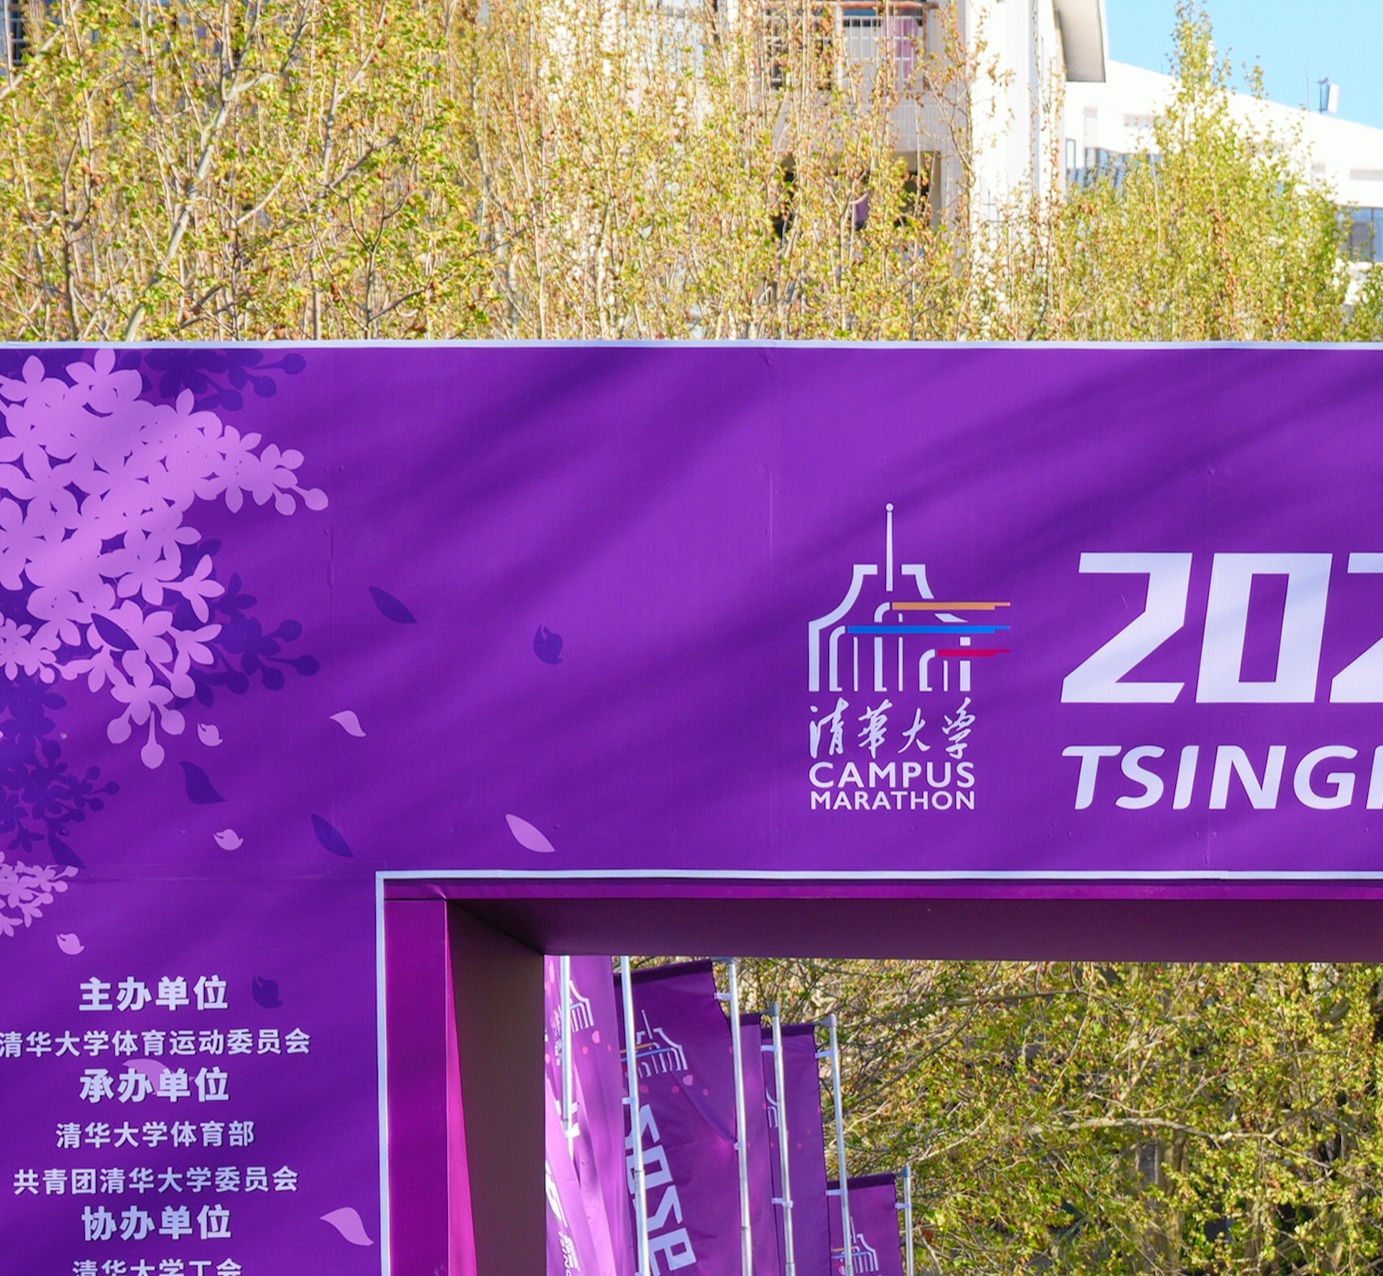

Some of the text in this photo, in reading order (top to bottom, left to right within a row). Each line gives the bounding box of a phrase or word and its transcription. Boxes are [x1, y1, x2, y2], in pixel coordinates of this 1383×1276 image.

[809, 762, 975, 789] CAMPUS
[810, 790, 975, 811] MARATHON
[79, 975, 229, 1012] 主办单位
[0, 1028, 311, 1057] 清华大学体育运动委员会
[79, 1067, 230, 1103] 承办单位
[55, 1120, 255, 1149] 清华大学体育部
[13, 1166, 299, 1196] 共青团清华大学委员会
[81, 1205, 232, 1242] 协办单位
